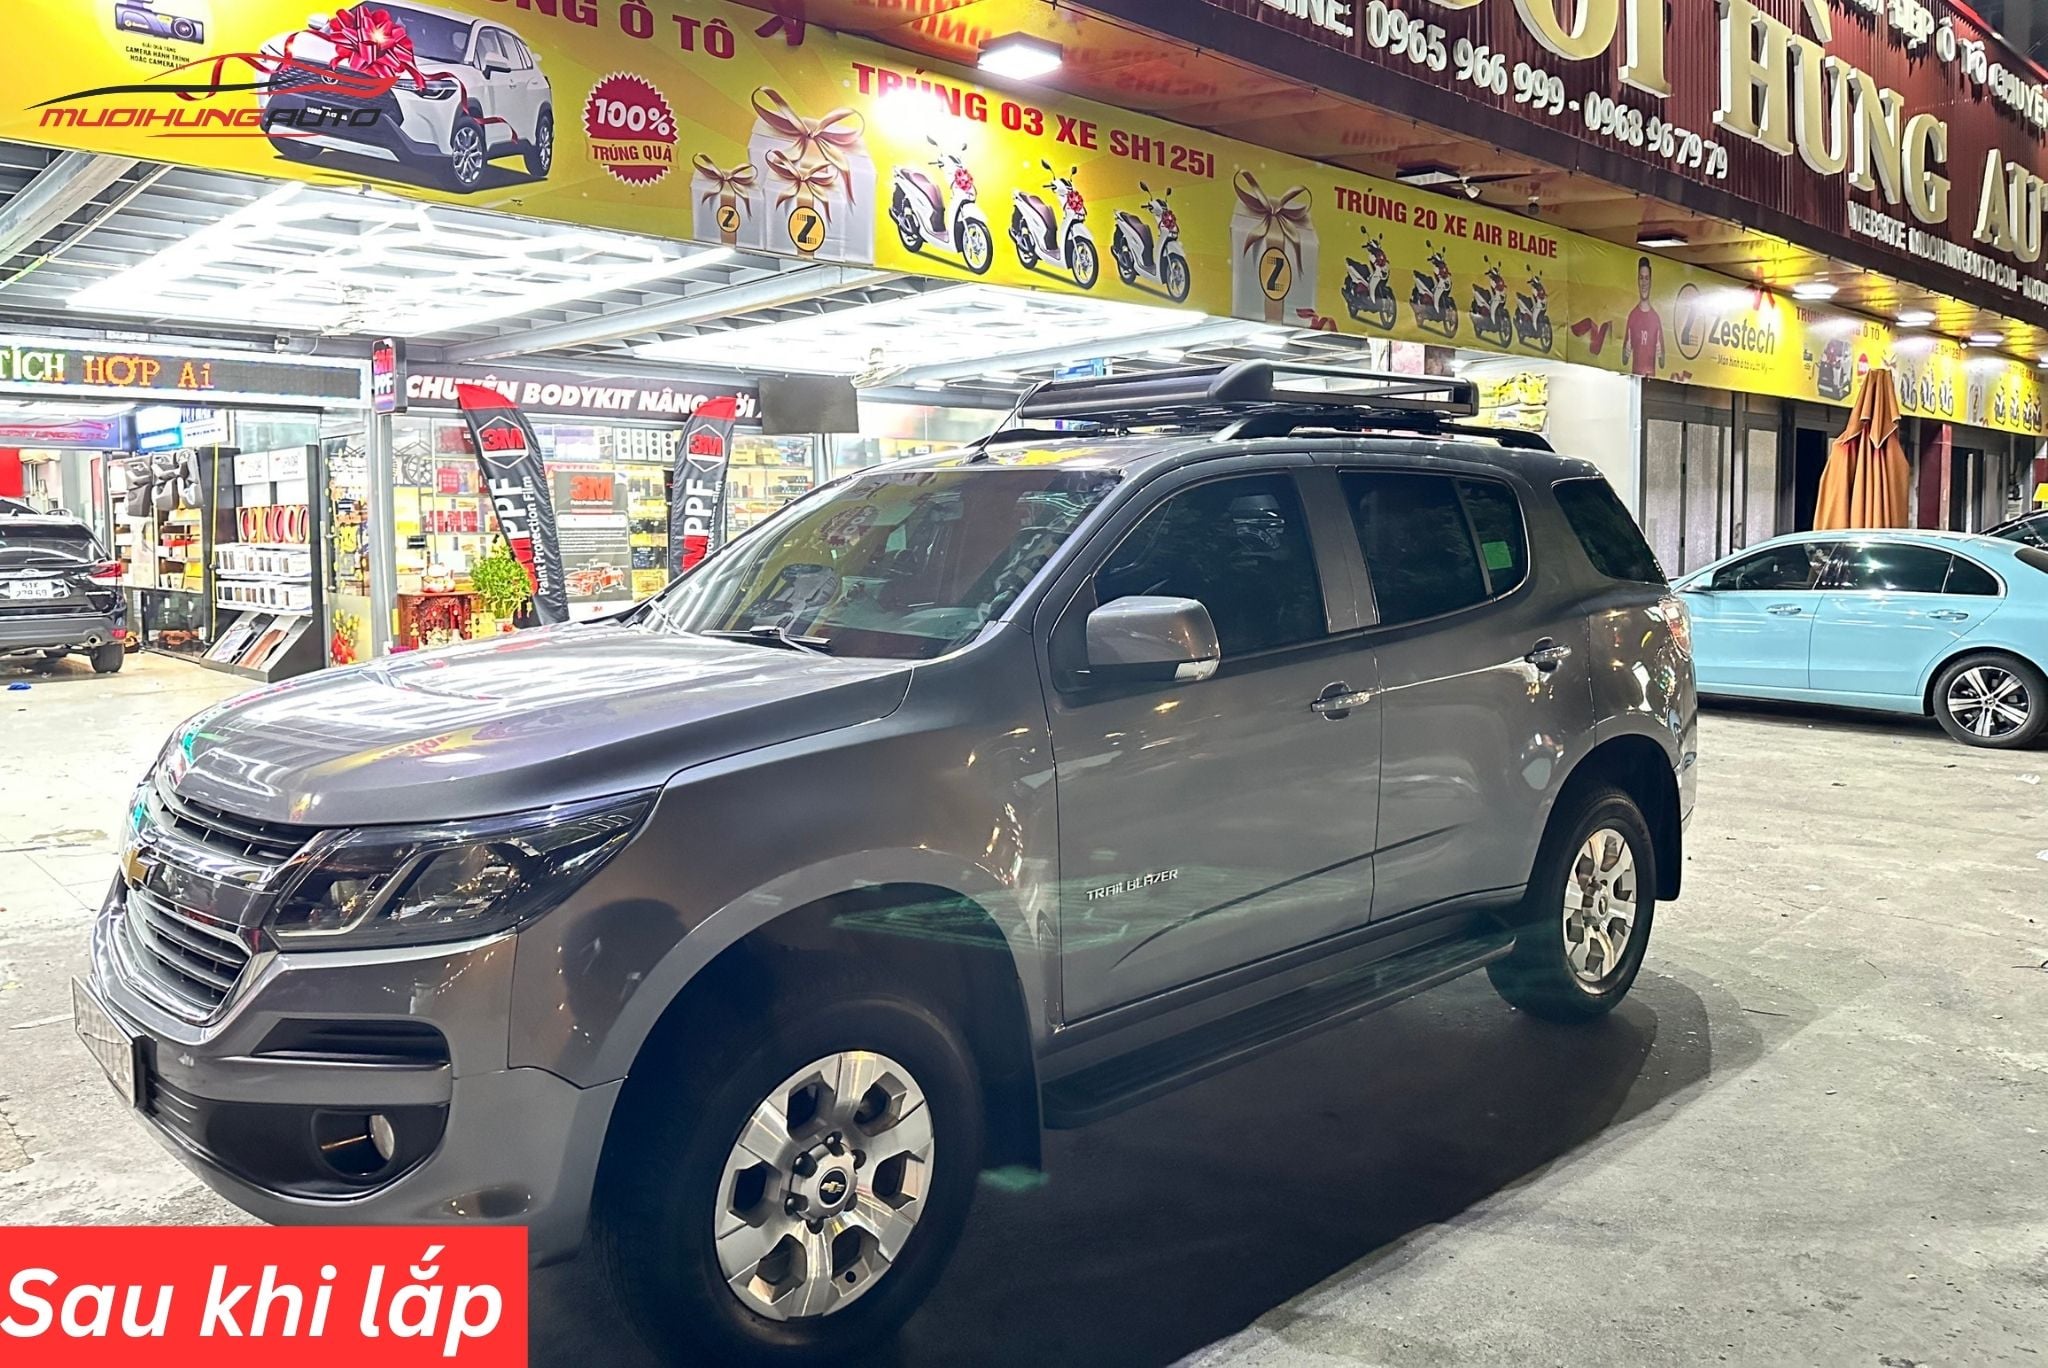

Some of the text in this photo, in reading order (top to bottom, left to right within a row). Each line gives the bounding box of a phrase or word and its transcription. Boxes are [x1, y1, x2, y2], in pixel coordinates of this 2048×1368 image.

[619, 0, 654, 39] Ô
[672, 17, 735, 59] TÔ
[1936, 16, 1956, 62] Ô
[1957, 37, 1987, 84] TÔ
[1366, 0, 1447, 72] 0965
[1453, 38, 1508, 95] 966
[1513, 62, 1565, 116] 999
[1584, 91, 1643, 147] 0968
[595, 98, 670, 136] 100%
[1001, 102, 1044, 136] 03
[1056, 114, 1097, 150] XE
[592, 144, 672, 162] TRÚNG QUÀ
[1334, 186, 1558, 258] TRÚNG 20 XE AIR BLADE
[1972, 149, 2048, 262] AU
[1708, 314, 1775, 355] Zestech
[177, 361, 214, 388] Ai
[407, 374, 519, 402] CHUÊN
[521, 382, 634, 413] BODYKIT
[482, 428, 525, 450] 3M
[690, 435, 723, 456] 3M
[488, 478, 531, 540] PPF
[570, 475, 612, 500] 3M
[684, 479, 714, 536] PPF
[521, 476, 550, 595] Paint Protection Film
